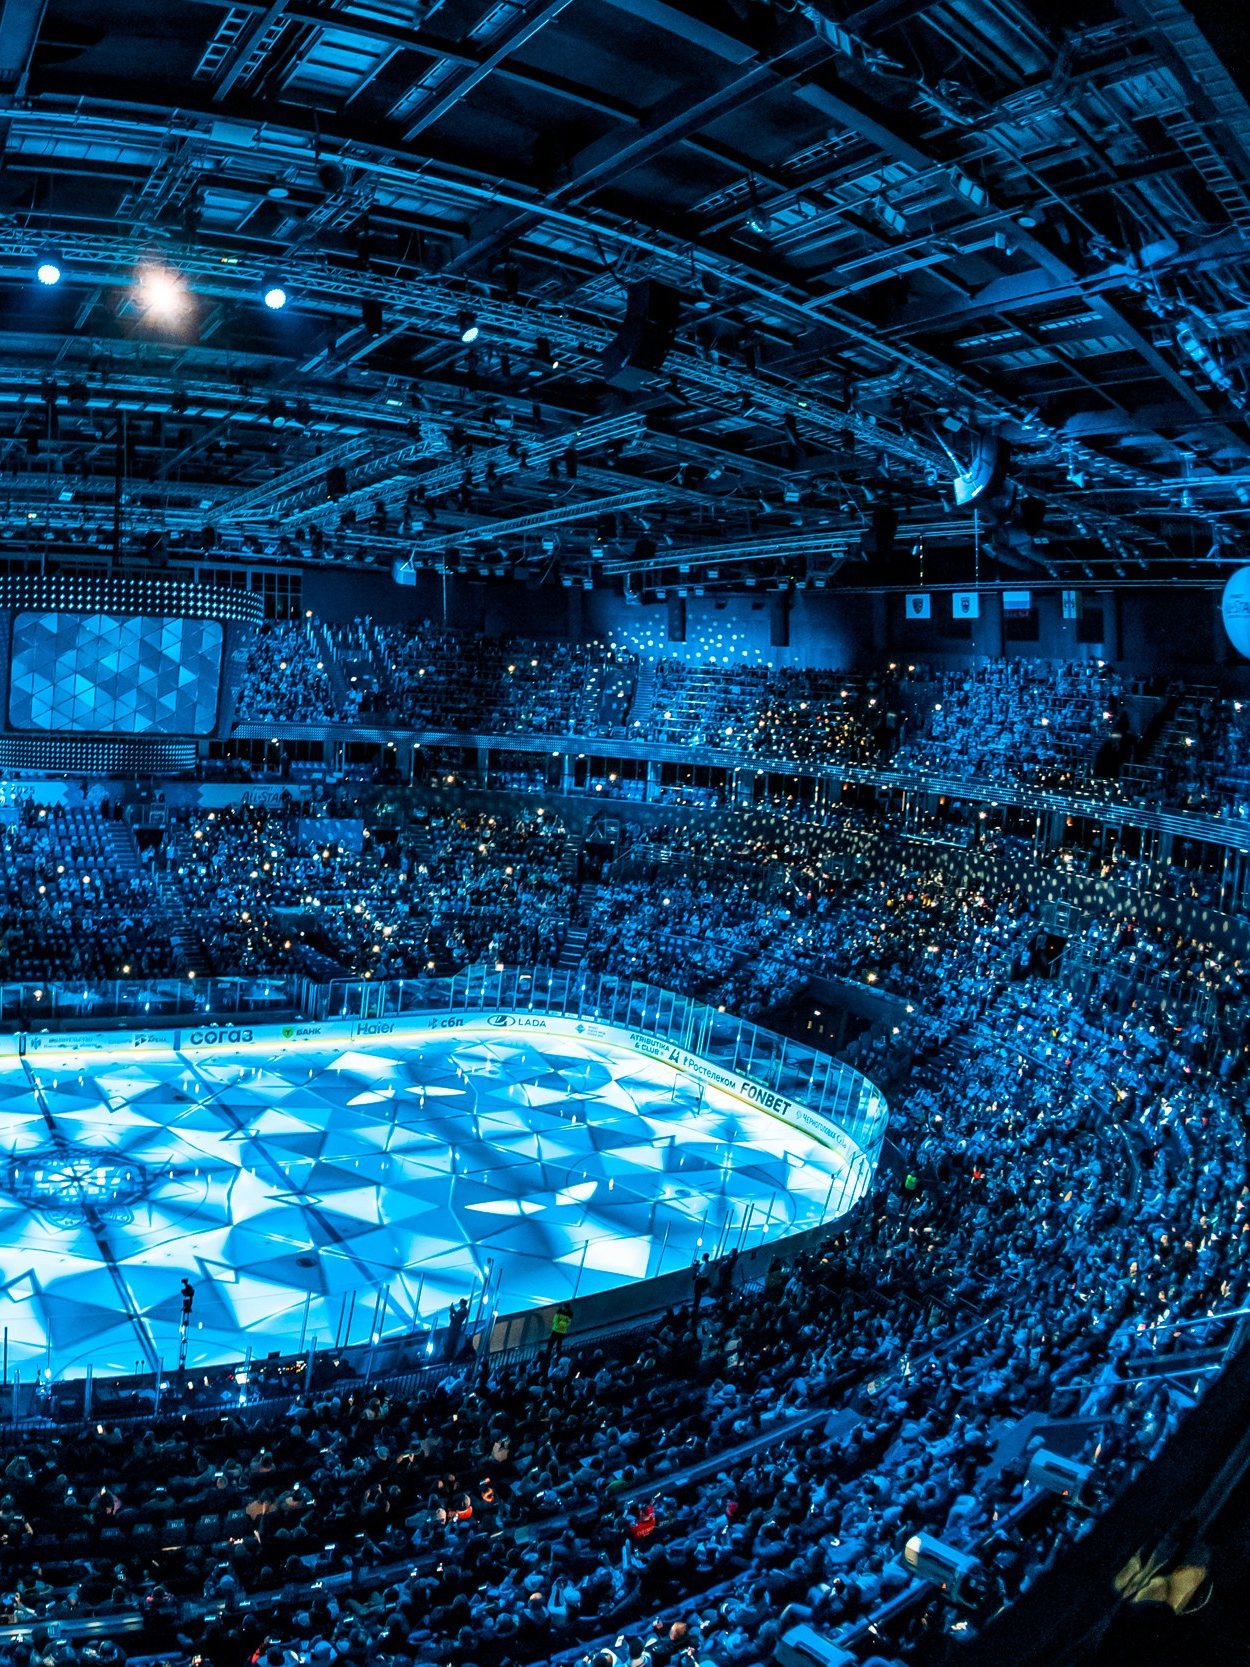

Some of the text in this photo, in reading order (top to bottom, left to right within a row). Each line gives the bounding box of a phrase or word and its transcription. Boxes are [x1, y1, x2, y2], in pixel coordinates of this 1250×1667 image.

[10, 785, 35, 794] 2025
[441, 1016, 464, 1028] сбп
[518, 1018, 547, 1028] LADA
[296, 1027, 322, 1036] БАНК
[357, 1022, 395, 1035] Haier
[630, 1033, 670, 1052] ATRIBUTIKA
[641, 1044, 659, 1056] CLUB
[688, 1058, 736, 1089] Ростелеком
[739, 1081, 792, 1116] FONBET
